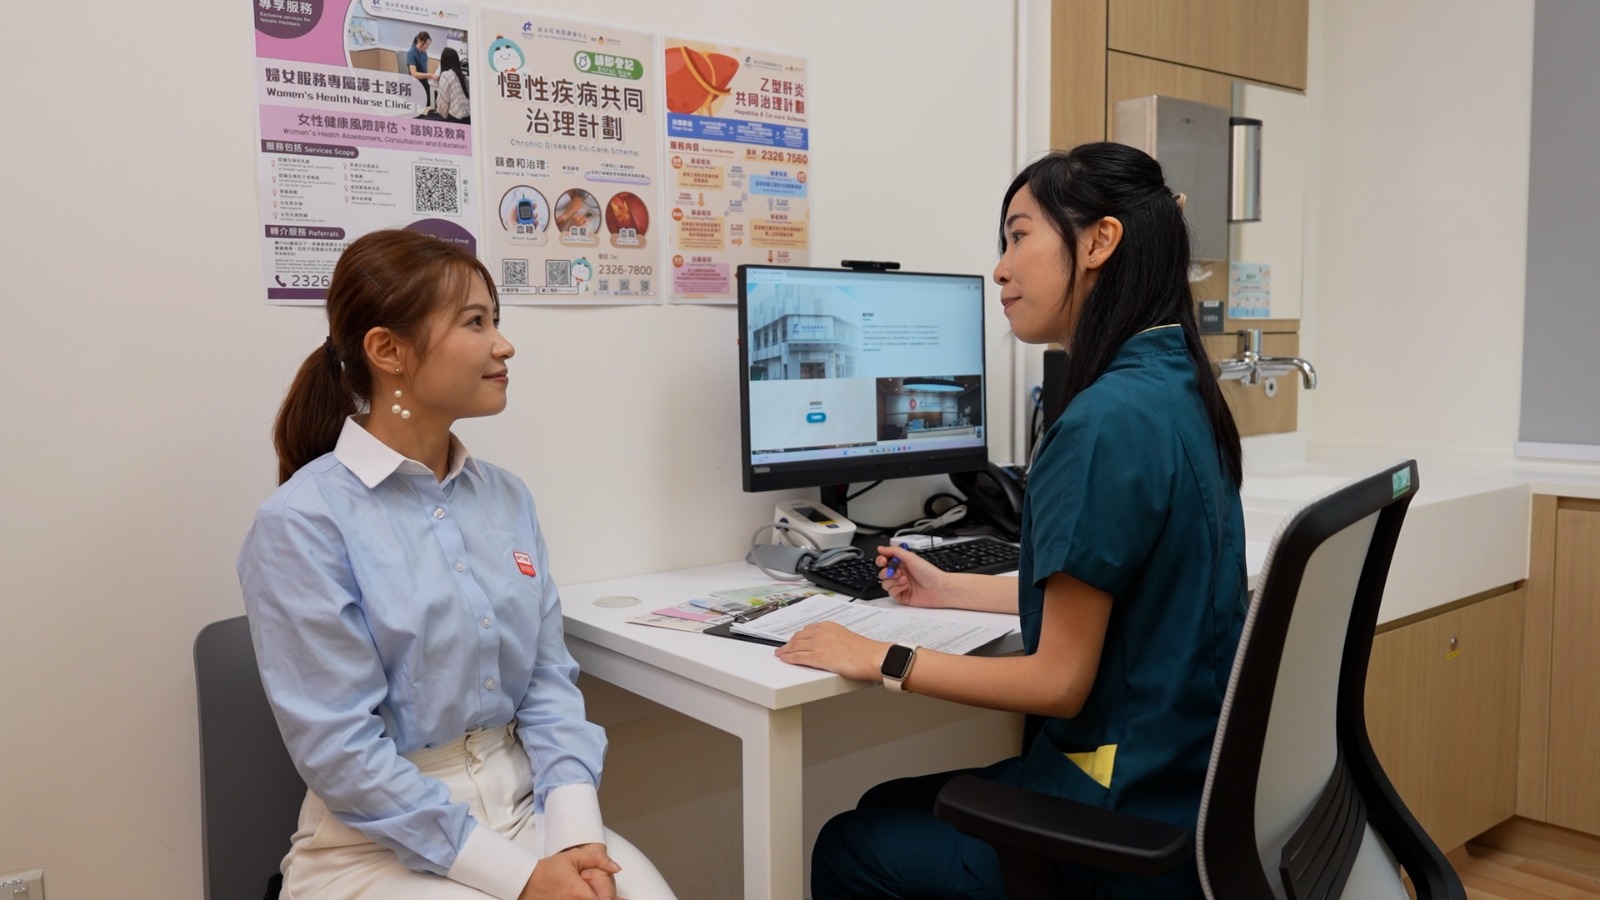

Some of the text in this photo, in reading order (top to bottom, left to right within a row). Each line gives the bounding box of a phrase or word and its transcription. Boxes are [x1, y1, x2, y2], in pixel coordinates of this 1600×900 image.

[265, 67, 412, 98] 婦女服務專屬護士診所
[498, 71, 643, 113] 慢性疾病共同
[760, 77, 804, 98] 乙型肝炎
[266, 87, 412, 110] Women's Health Nurse Clinic
[736, 92, 804, 114] 共同治理計劃
[526, 107, 623, 141] 治理計劃
[304, 146, 332, 154] Services
[510, 138, 542, 147] Chronic
[545, 142, 575, 150] Disease
[598, 264, 652, 276] 2326-7800
[292, 275, 330, 287] 2326
